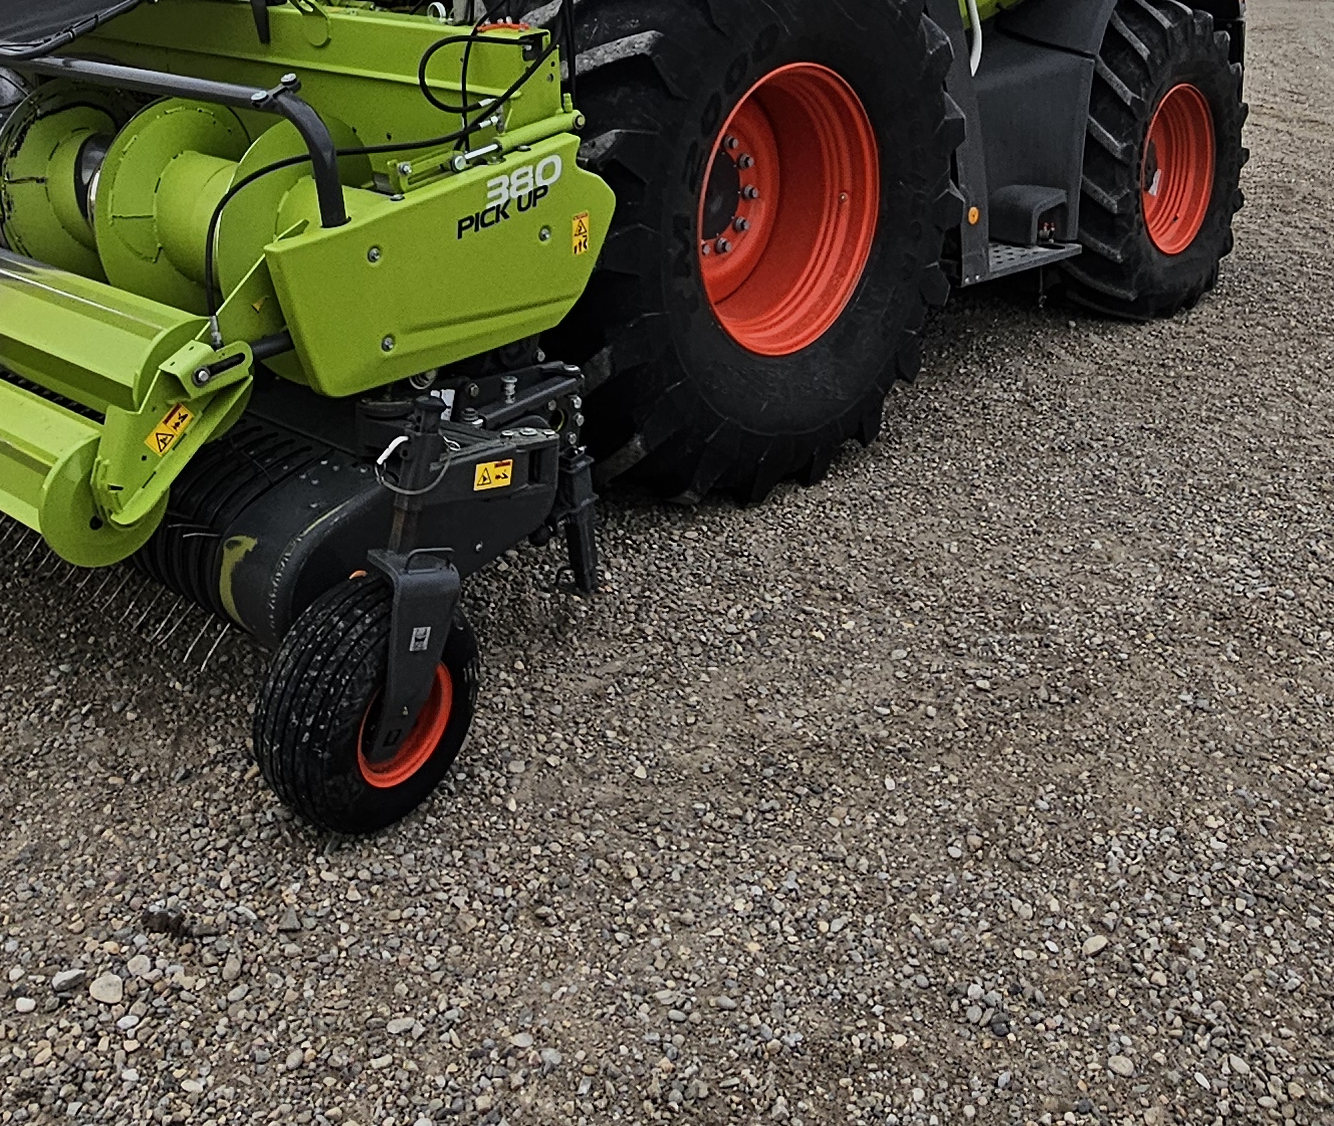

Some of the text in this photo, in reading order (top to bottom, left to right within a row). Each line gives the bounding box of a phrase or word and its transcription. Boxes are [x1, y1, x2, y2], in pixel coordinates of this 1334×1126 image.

[485, 154, 562, 210] 380
[456, 184, 549, 240] PICK UP
